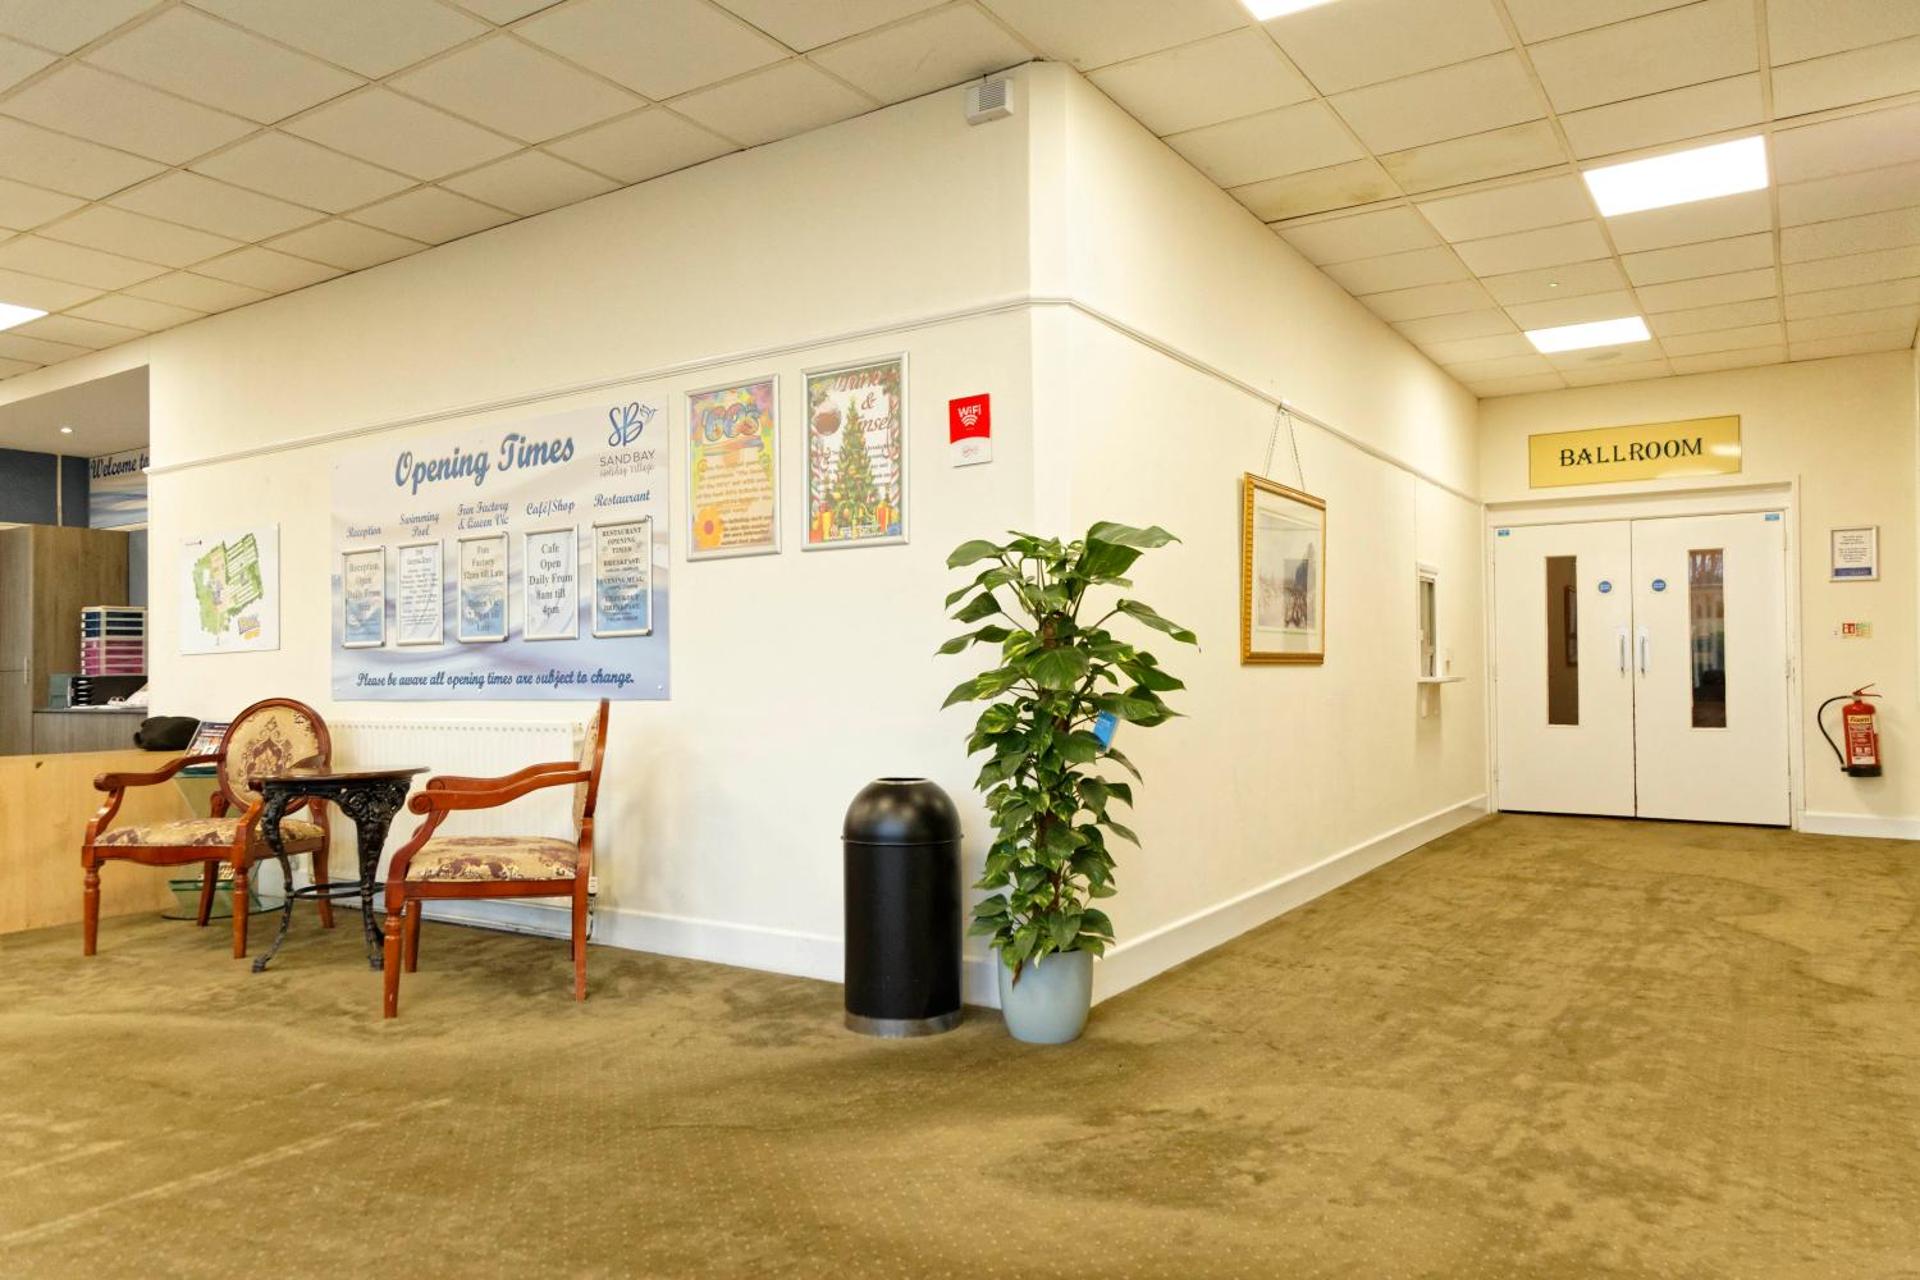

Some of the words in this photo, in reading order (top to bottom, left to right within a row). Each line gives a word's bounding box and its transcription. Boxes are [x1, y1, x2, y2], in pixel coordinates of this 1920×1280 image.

[957, 403, 982, 418] WiFi
[599, 453, 632, 467] SAND
[633, 449, 655, 462] BAY
[1560, 437, 1704, 468] BALLROOM
[90, 457, 137, 479] Welcome
[394, 449, 490, 495] Opening
[498, 433, 575, 472] Times
[593, 490, 650, 508] Restaurant
[457, 503, 475, 516] Fun
[476, 501, 509, 514] Factory
[526, 499, 576, 517] Café/Shop
[399, 512, 440, 525] Swimming
[457, 521, 465, 530] &
[495, 514, 510, 526] Vic
[346, 525, 382, 538] Reception
[411, 525, 430, 537] Pool
[602, 527, 642, 537] RESTAURANT
[607, 537, 636, 547] OPENING
[612, 546, 632, 555] TIMES
[540, 559, 561, 571] Open
[529, 575, 549, 587] Daily
[551, 573, 573, 584] From
[554, 588, 566, 598] till
[356, 672, 386, 687] Please
[387, 672, 398, 686] be
[399, 675, 428, 686] aware
[429, 671, 445, 685] all
[447, 673, 486, 689] opening
[487, 672, 513, 686] times
[515, 674, 534, 685] are
[535, 669, 574, 689] subject
[576, 671, 588, 684] to
[590, 668, 635, 688] change.
